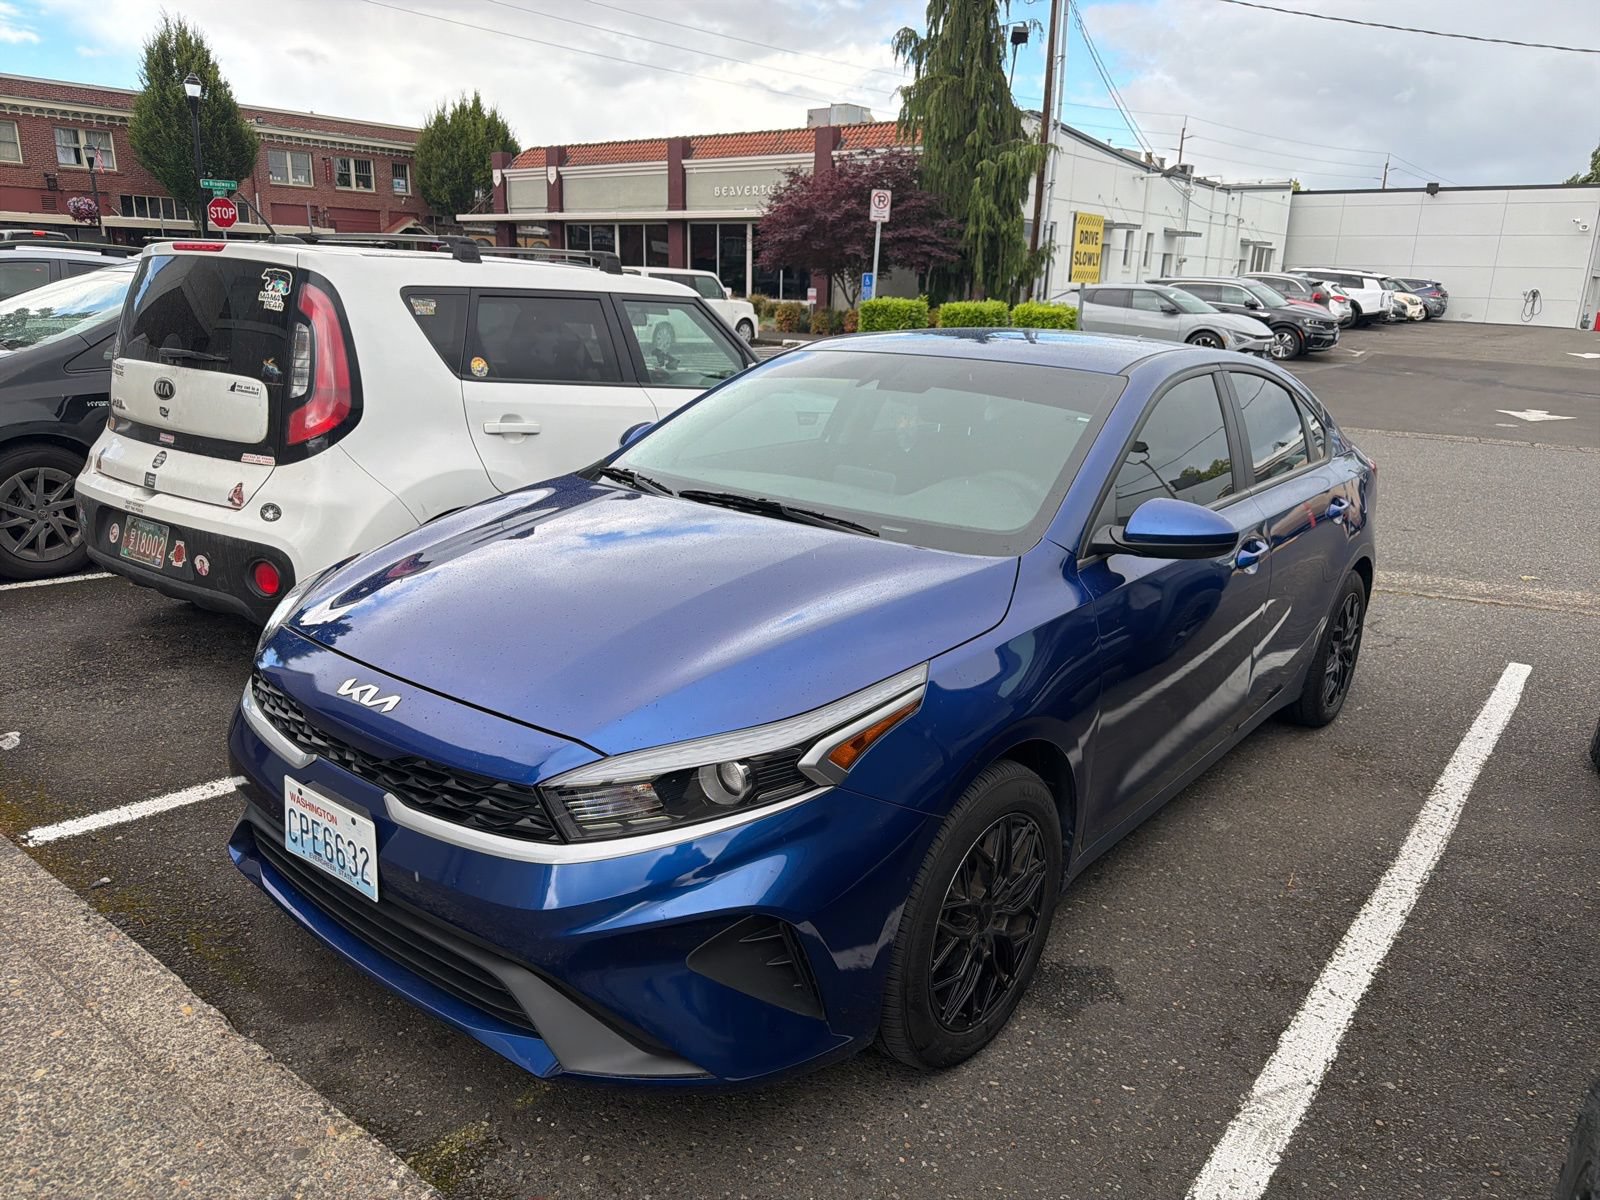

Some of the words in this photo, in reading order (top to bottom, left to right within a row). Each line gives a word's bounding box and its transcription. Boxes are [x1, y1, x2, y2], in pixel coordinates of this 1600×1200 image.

[210, 206, 235, 219] STOP
[1079, 230, 1100, 246] DRIVE
[1074, 250, 1100, 267] SLOWLY
[260, 292, 281, 301] MAMA
[156, 381, 170, 396] KIA
[136, 530, 165, 558] 18002
[337, 678, 402, 714] KIA
[289, 791, 338, 826] WASHINGTON
[288, 808, 371, 886] CPE6632
[308, 852, 337, 872] EVERGREEN
